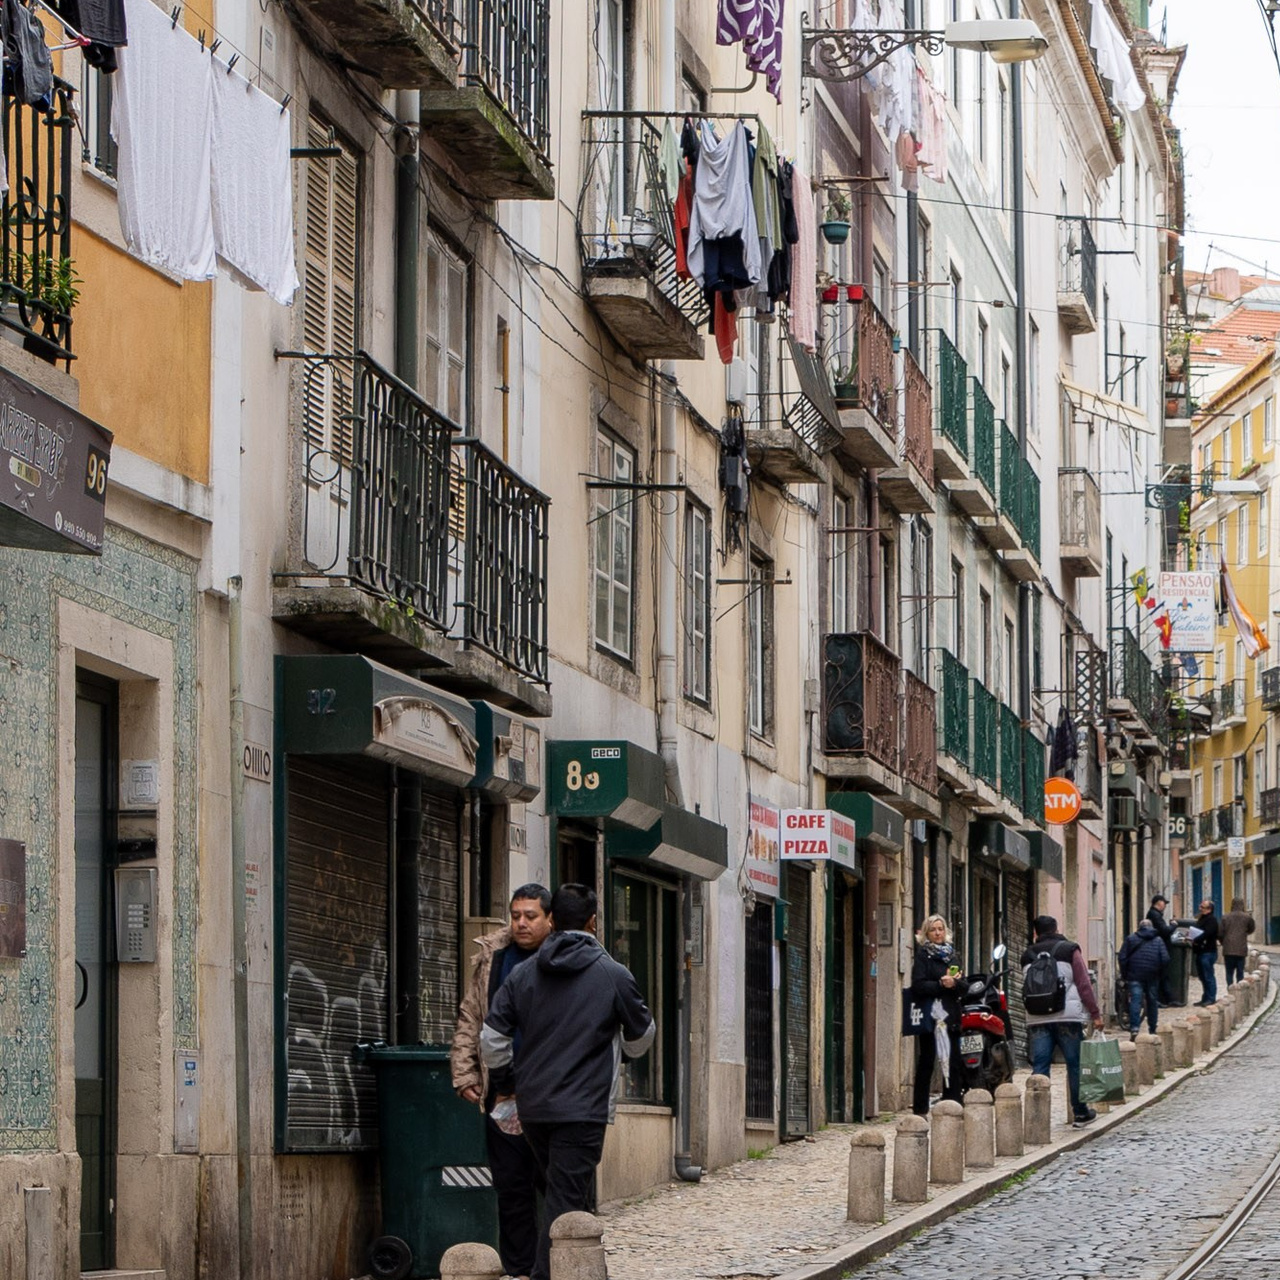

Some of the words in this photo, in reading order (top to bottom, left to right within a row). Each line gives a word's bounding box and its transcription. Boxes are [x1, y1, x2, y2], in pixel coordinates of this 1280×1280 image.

[87, 453, 106, 495] 96
[1044, 793, 1077, 809] ATM
[786, 814, 826, 829] CAFE
[784, 840, 829, 854] PIZZA
